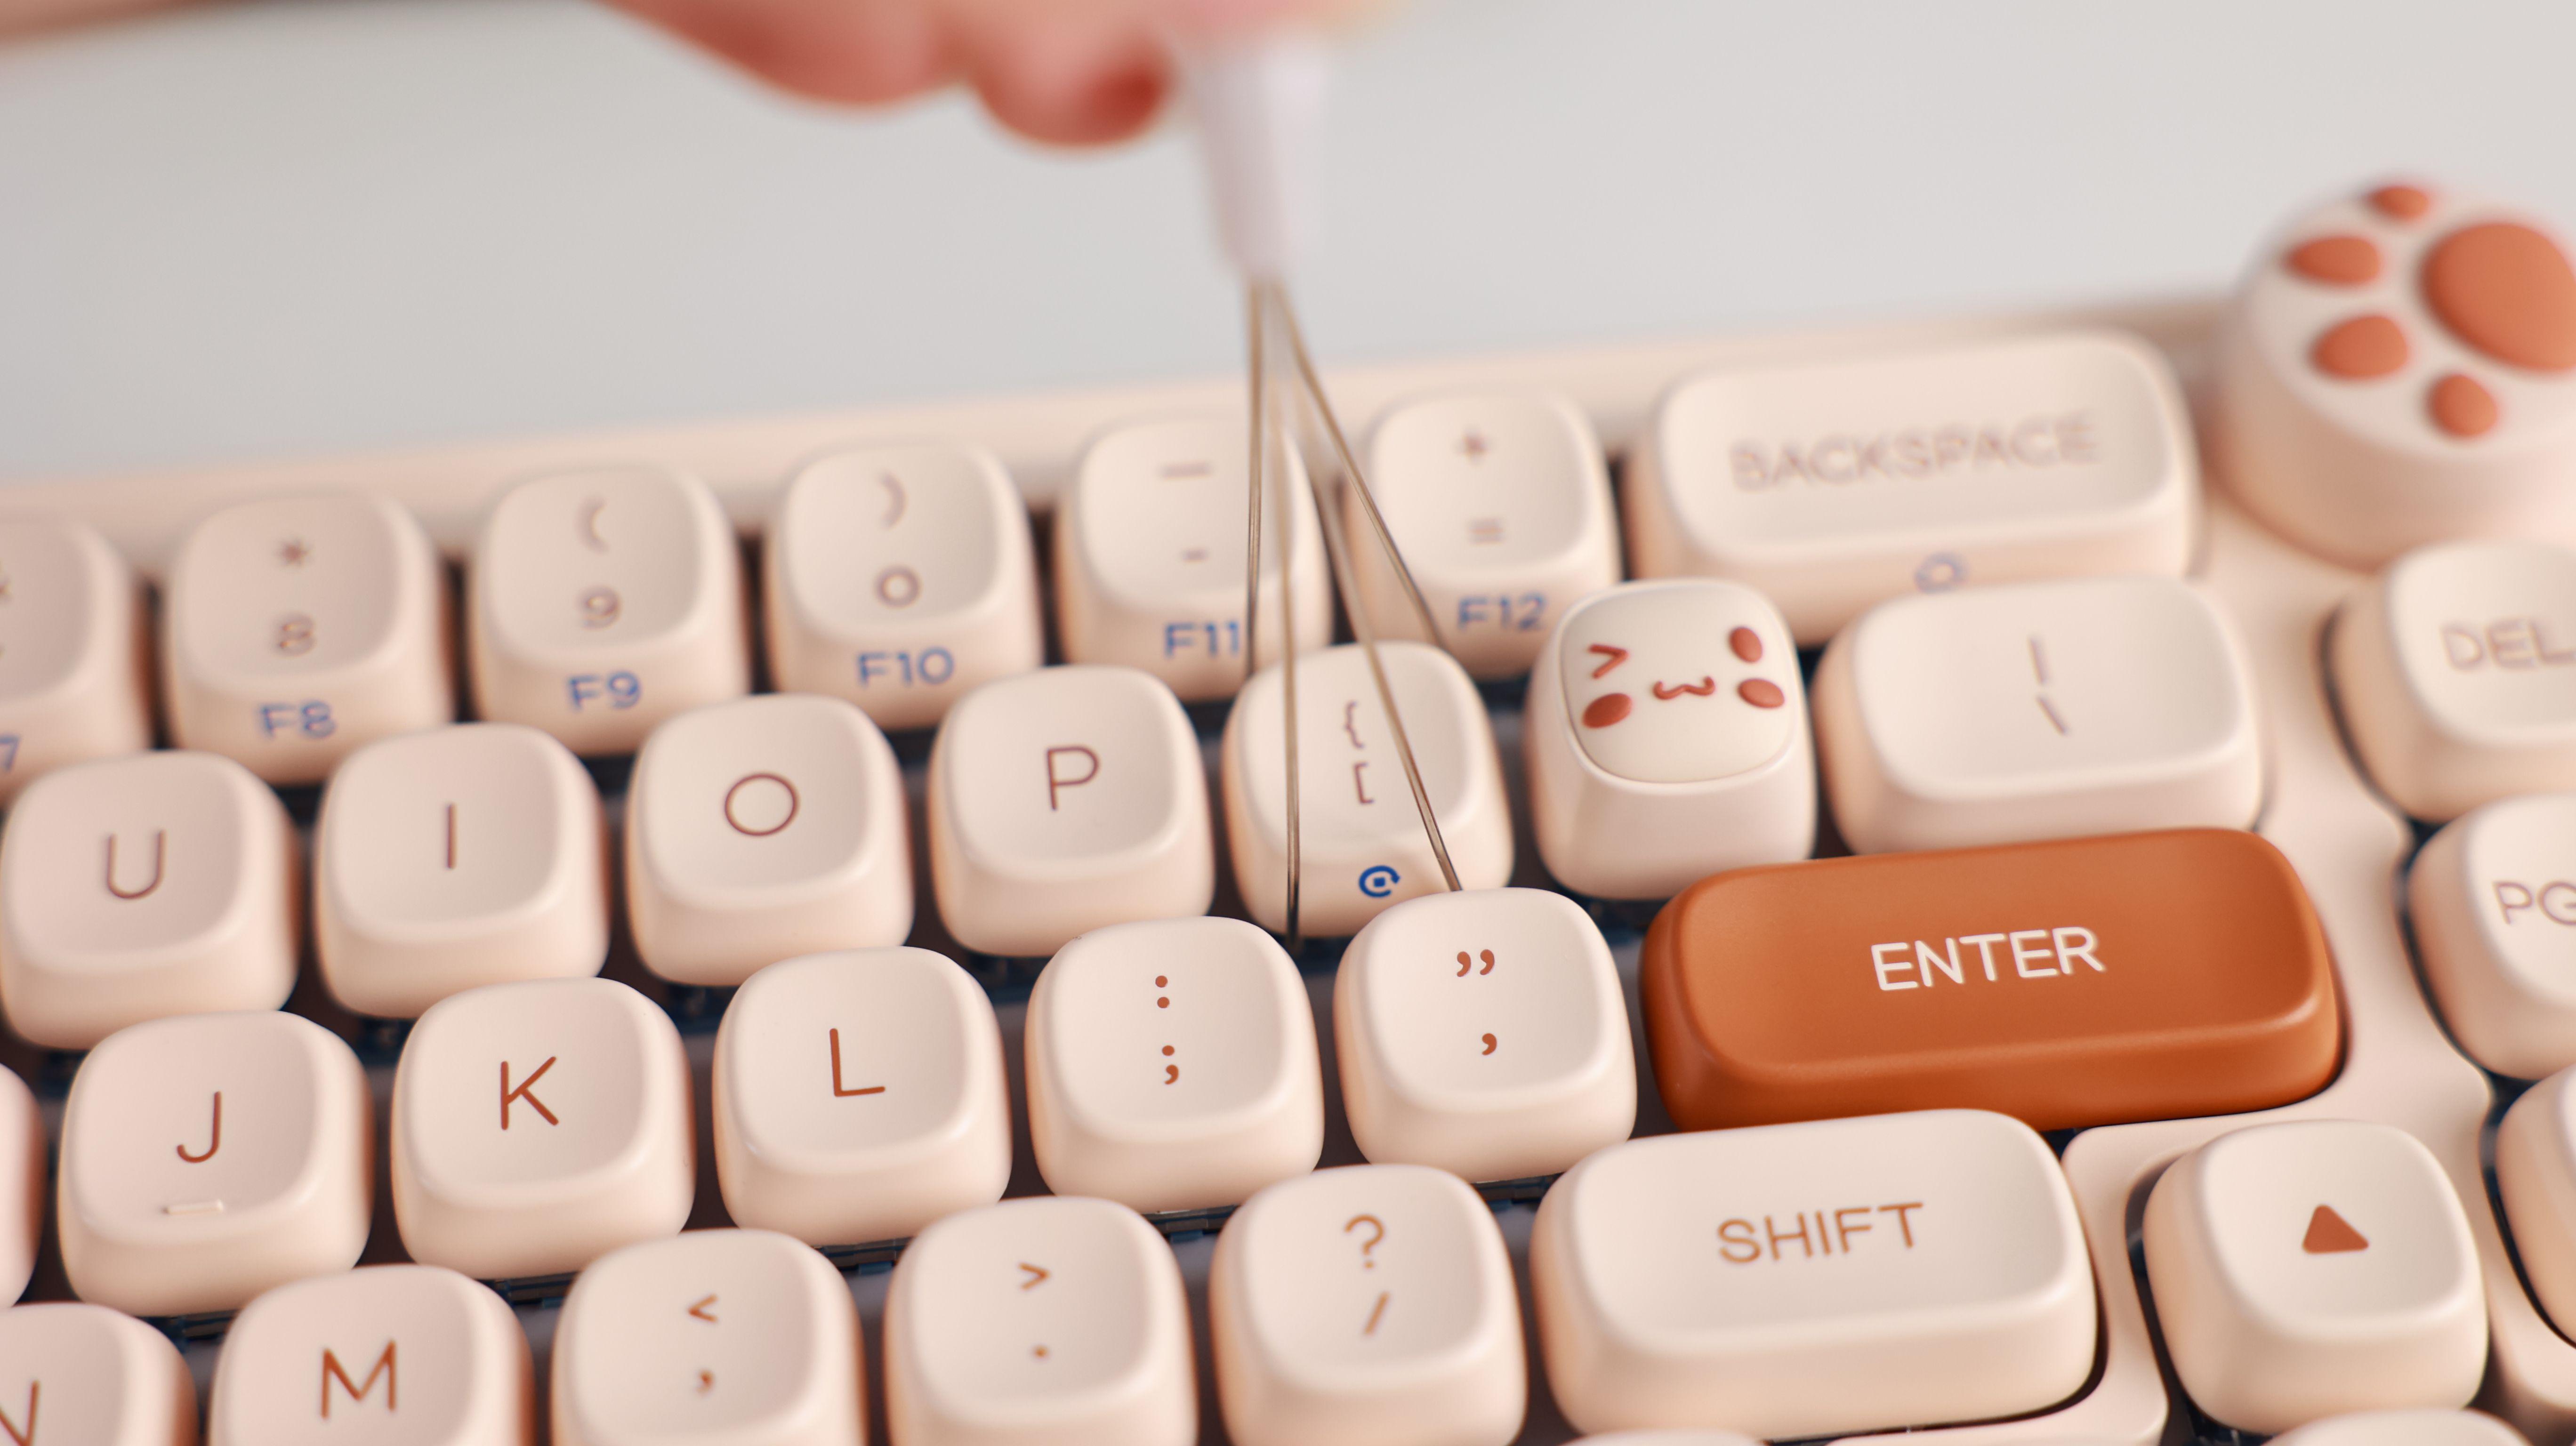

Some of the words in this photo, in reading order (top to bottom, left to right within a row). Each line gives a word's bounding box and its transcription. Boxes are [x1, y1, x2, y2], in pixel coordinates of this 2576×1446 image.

[1458, 429, 1488, 458] +
[1730, 413, 2097, 491] BACKSPACE
[880, 474, 907, 528] )
[578, 498, 607, 552] (
[579, 586, 622, 628] 9
[1457, 594, 1546, 631] F12
[277, 614, 315, 655] 8
[1165, 622, 1238, 658] F11
[858, 647, 953, 685] F10
[567, 672, 640, 708] F9
[258, 700, 336, 739] F8
[1344, 701, 1364, 749] {
[1046, 745, 1100, 811] P
[1353, 762, 1374, 805] [
[723, 772, 799, 837] O
[104, 831, 165, 900] U
[1871, 926, 2105, 991] ENTER
[1155, 975, 1170, 1008] :
[829, 1028, 886, 1097] L
[1162, 1045, 1179, 1084] ;
[500, 1056, 559, 1130] K
[177, 1092, 221, 1163] J
[1344, 1214, 1385, 1269] ?
[1717, 1202, 1923, 1263] SHIFT
[1020, 1263, 1049, 1289] >
[688, 1296, 716, 1322] <
[1364, 1292, 1389, 1334] /
[321, 1342, 396, 1418] M
